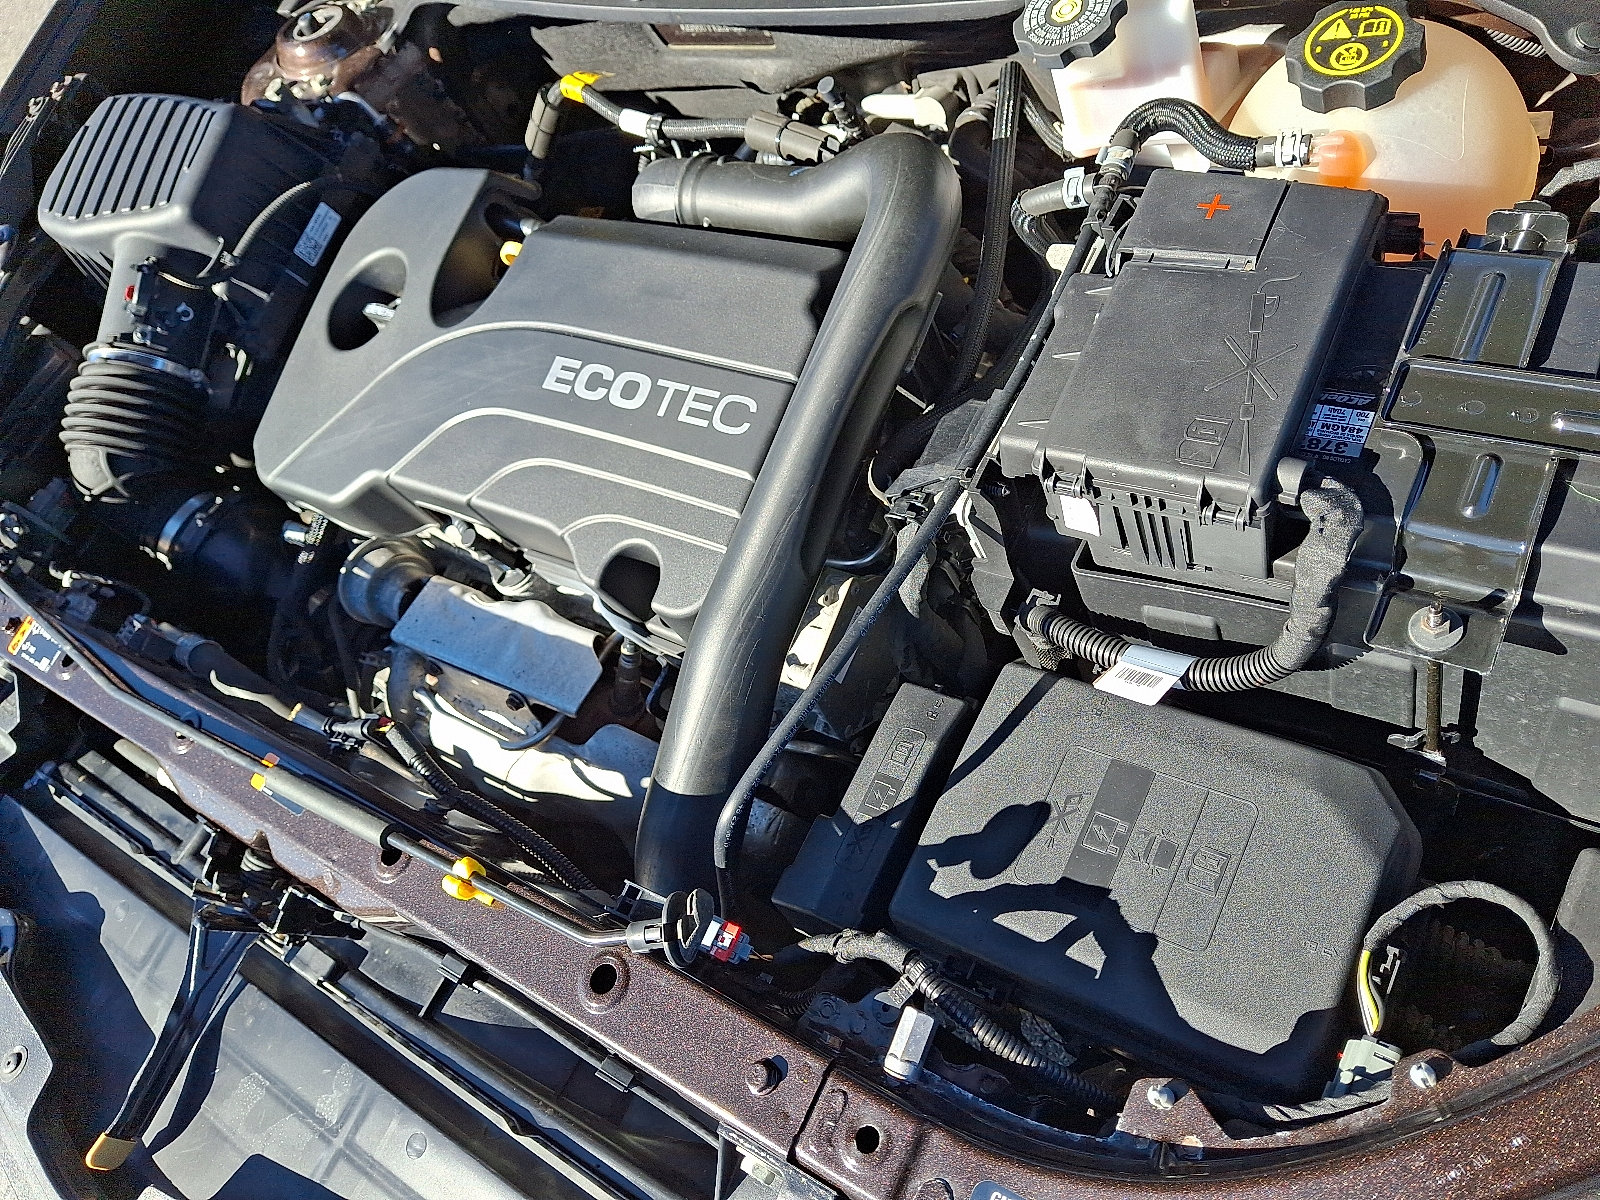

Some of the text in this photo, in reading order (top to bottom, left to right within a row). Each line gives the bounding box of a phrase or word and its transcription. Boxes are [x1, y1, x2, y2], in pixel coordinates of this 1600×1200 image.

[541, 355, 758, 435] ECOTEC
[1320, 393, 1372, 405] ACDel
[1356, 411, 1370, 419] 700
[1321, 422, 1364, 434] 48AGM
[1300, 438, 1349, 454] 378
